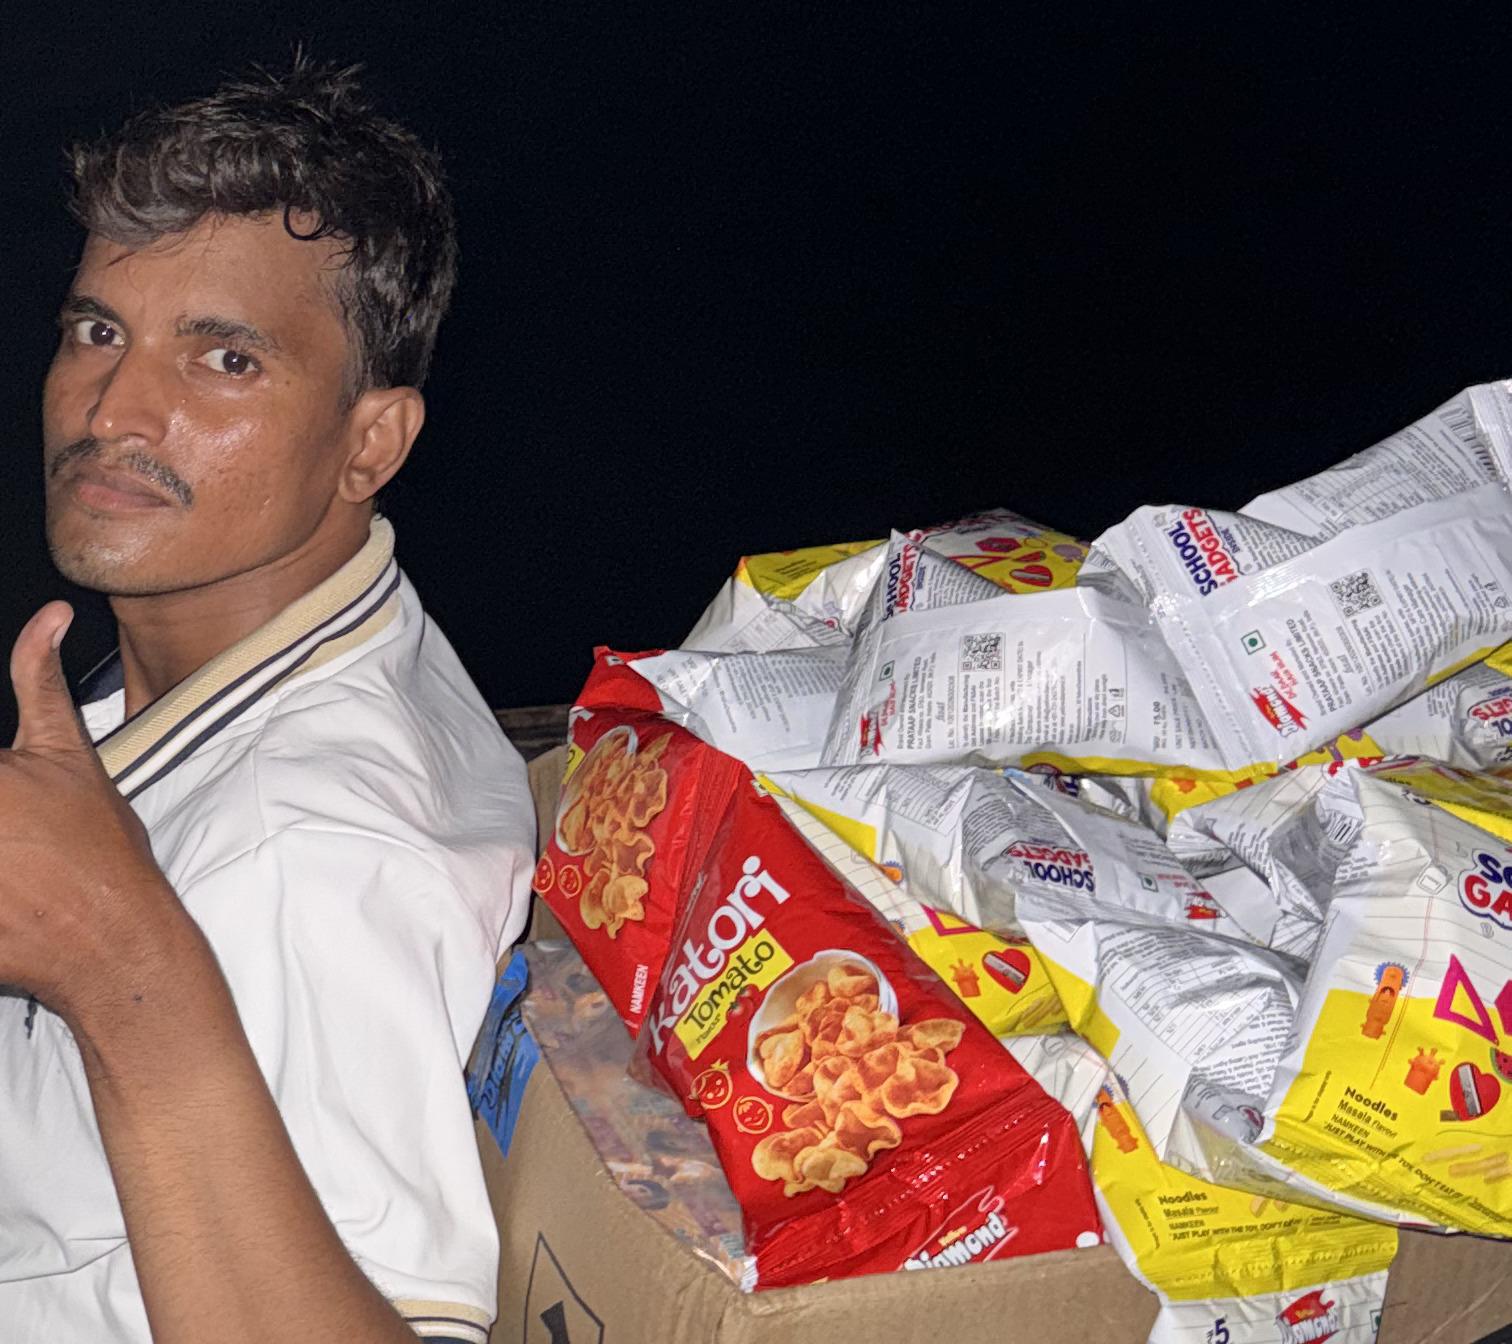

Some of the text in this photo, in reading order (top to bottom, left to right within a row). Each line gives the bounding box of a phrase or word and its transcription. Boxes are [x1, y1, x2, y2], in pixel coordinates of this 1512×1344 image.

[897, 542, 920, 613] ADGETS
[1168, 522, 1218, 596] SCHOOL
[1182, 508, 1239, 587] ADGETS
[1024, 860, 1096, 893] SCHOOL
[649, 855, 790, 1055] Katori
[683, 941, 775, 1029] Tomato
[629, 964, 649, 1014] NAMKEEN
[1336, 1098, 1374, 1125] Masala
[1343, 1085, 1401, 1122] Noodles
[1158, 1189, 1207, 1205] Noodles
